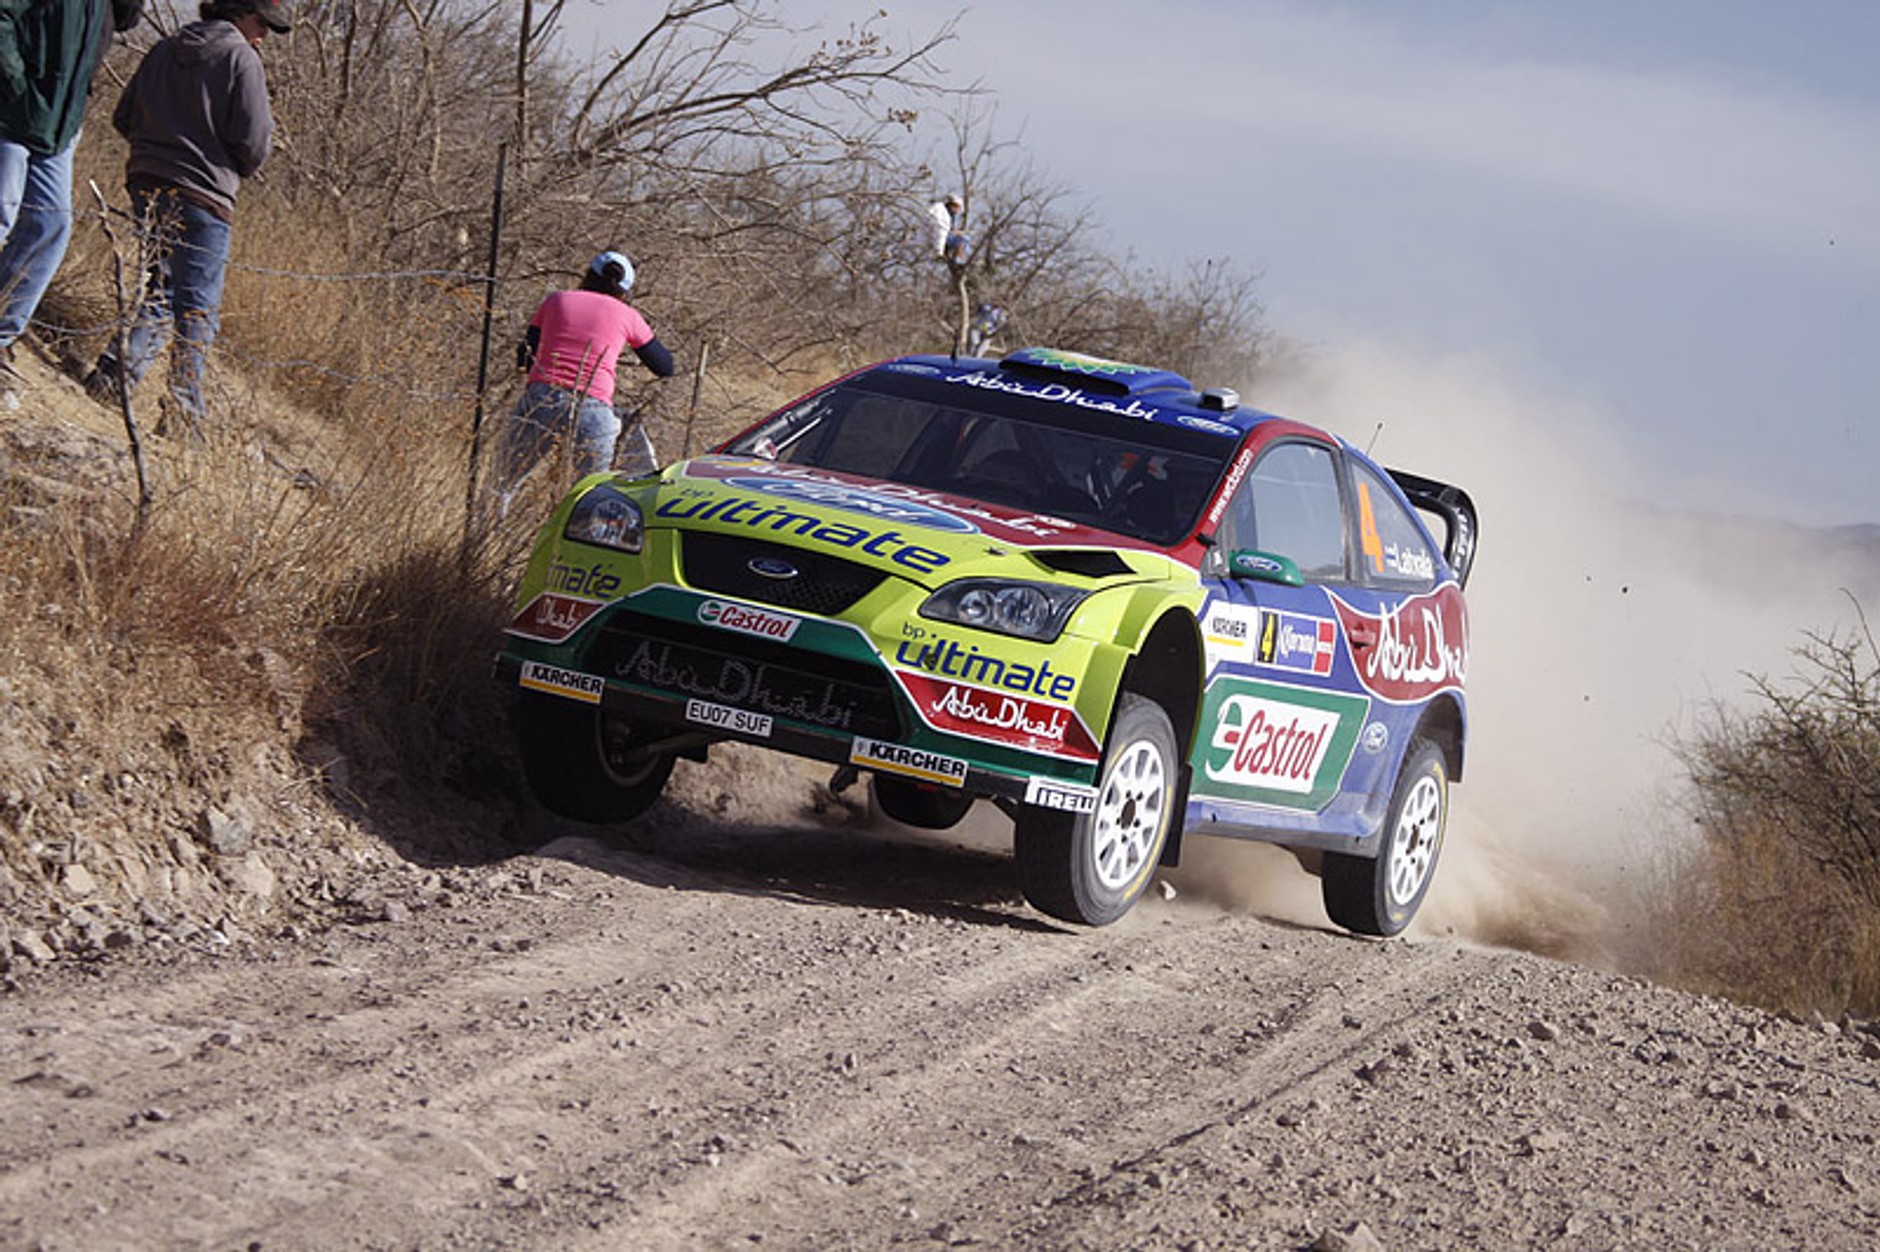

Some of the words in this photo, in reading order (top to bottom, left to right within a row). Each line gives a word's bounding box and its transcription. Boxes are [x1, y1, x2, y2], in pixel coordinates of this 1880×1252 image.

[1032, 383, 1159, 421] Dhabi
[655, 497, 951, 574] ultimate
[1359, 482, 1384, 573] 4
[720, 606, 793, 638] Castrol
[902, 621, 926, 640] bp
[895, 638, 1076, 701] ultimate
[689, 703, 731, 726] EU07
[733, 710, 771, 733] SUF
[998, 697, 1068, 741] Dhabi
[1234, 709, 1328, 780] Castrol
